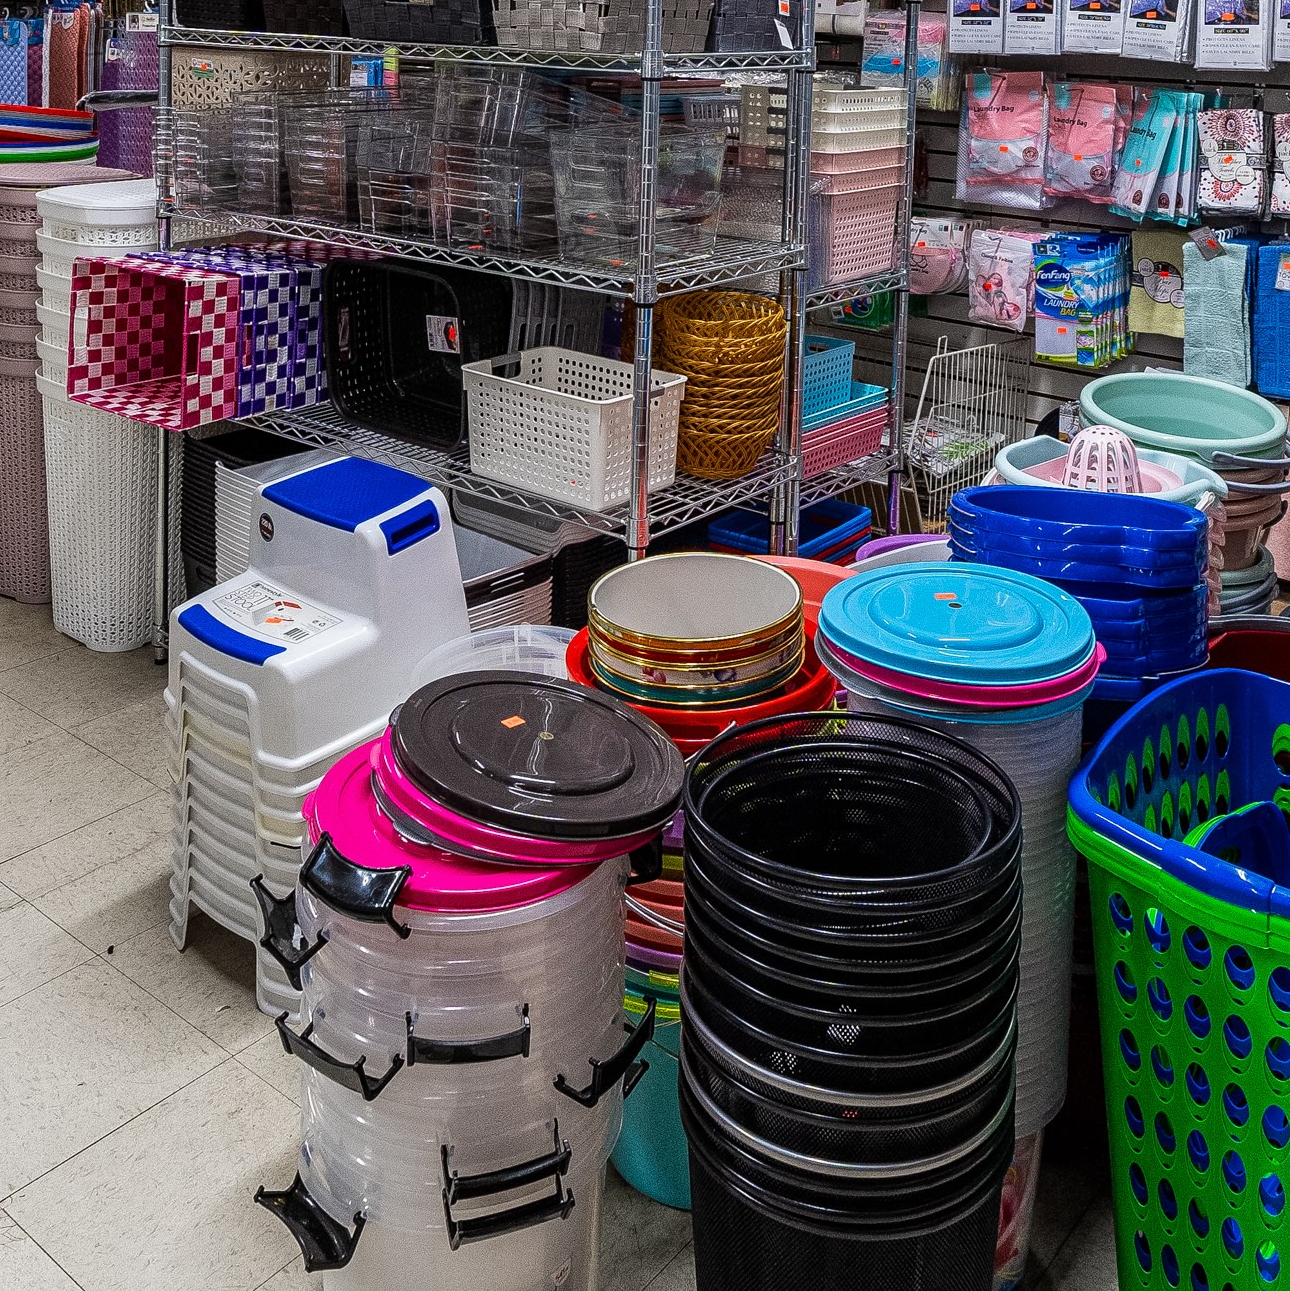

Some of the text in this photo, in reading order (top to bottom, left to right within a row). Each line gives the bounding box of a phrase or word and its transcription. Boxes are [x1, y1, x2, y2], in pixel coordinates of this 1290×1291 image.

[973, 105, 1014, 115] Laundry Bag
[1053, 117, 1088, 128] Laundry Bag
[1037, 270, 1071, 282] FenFang
[1044, 298, 1080, 309] LAUNDRY
[1060, 307, 1076, 317] BAG
